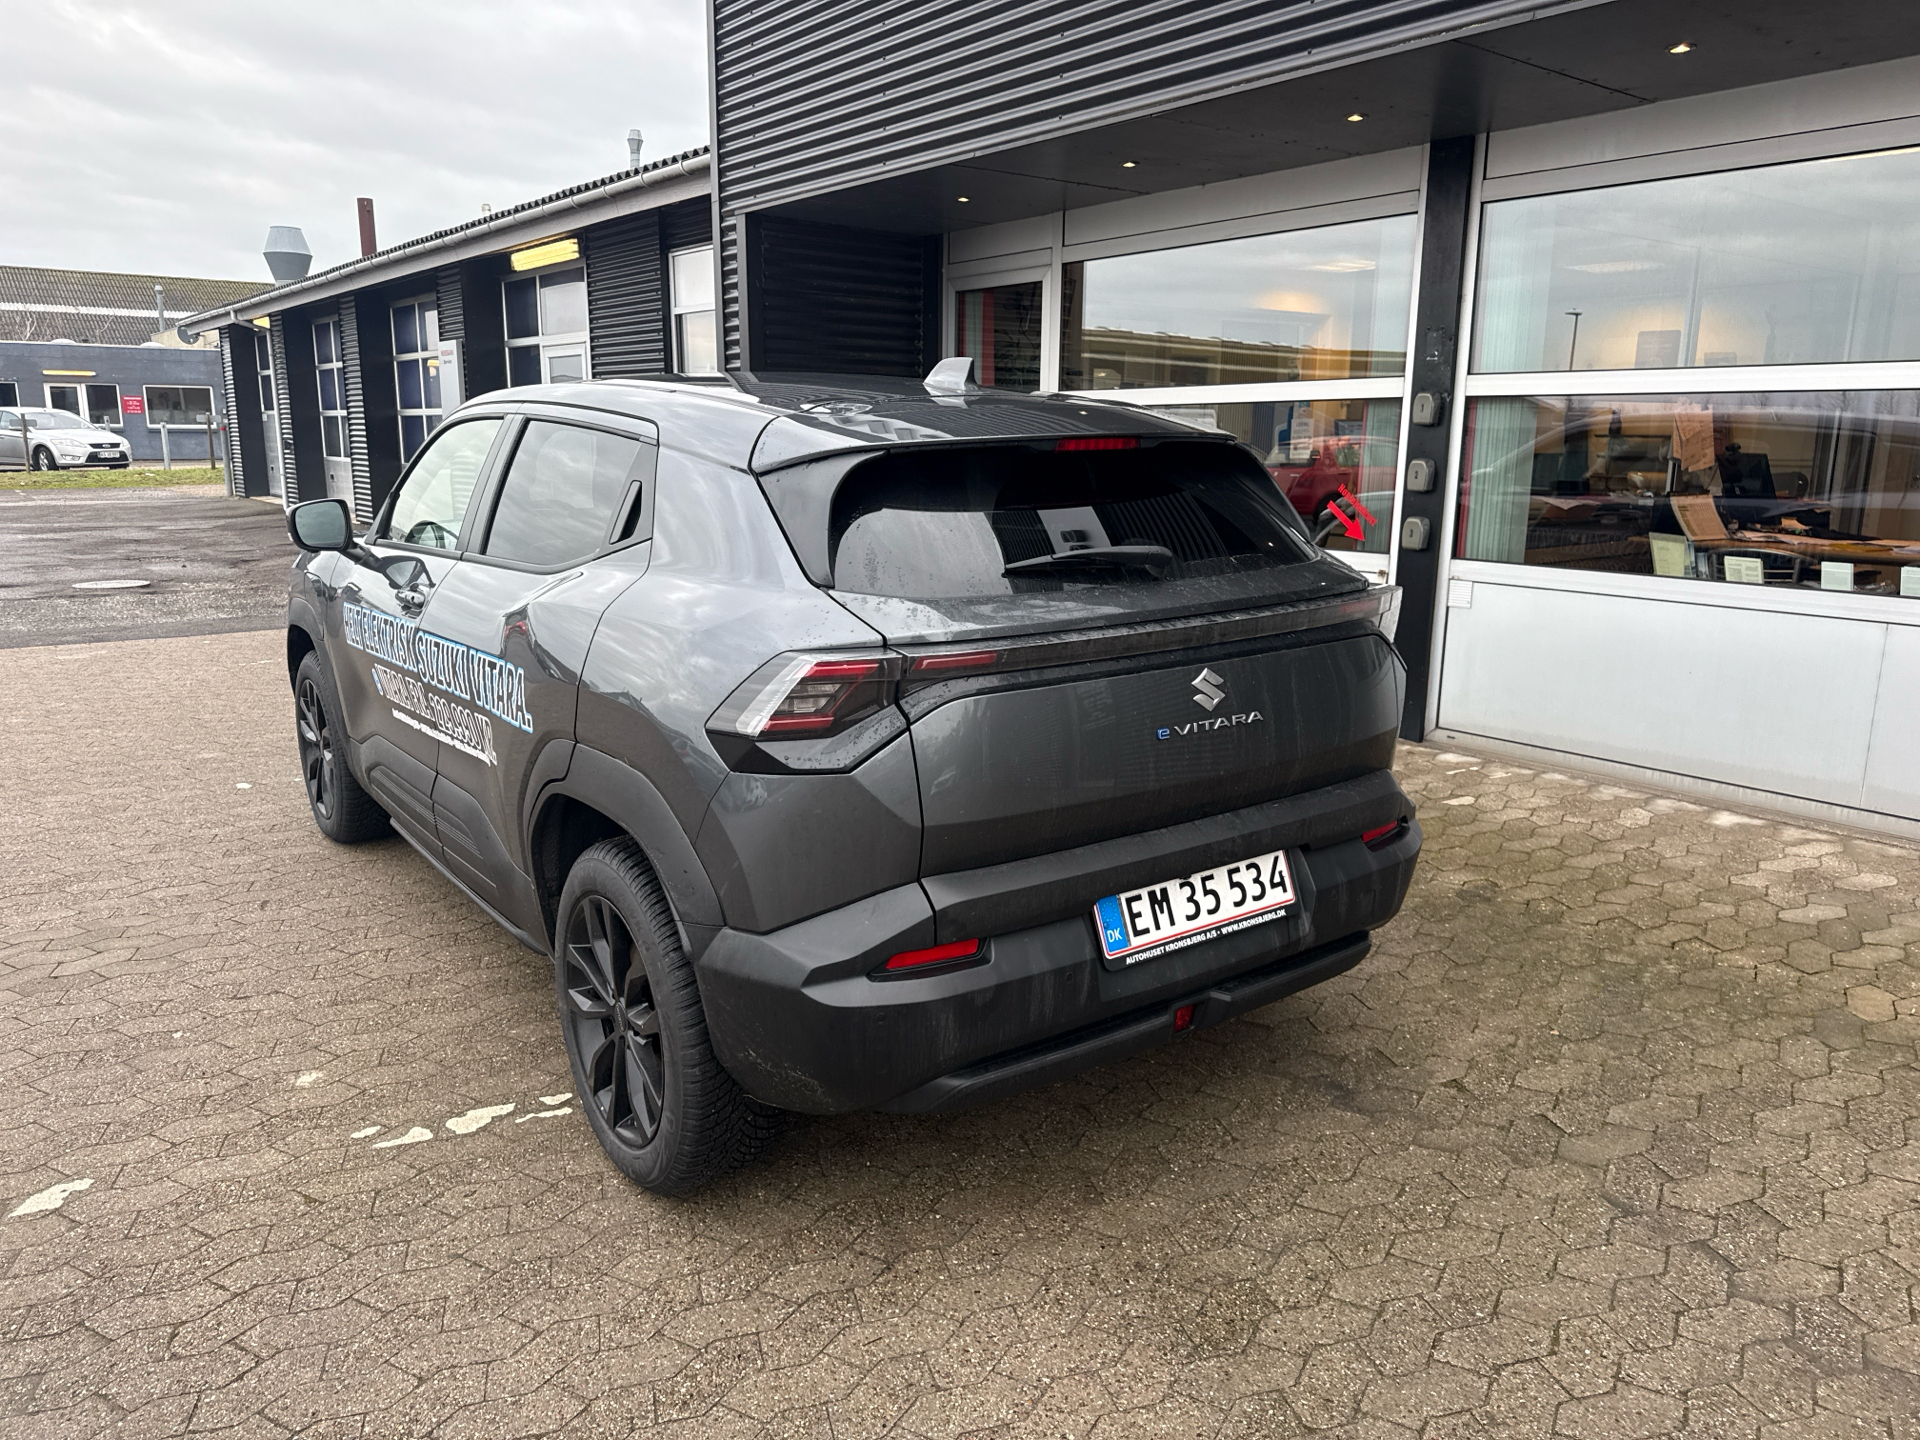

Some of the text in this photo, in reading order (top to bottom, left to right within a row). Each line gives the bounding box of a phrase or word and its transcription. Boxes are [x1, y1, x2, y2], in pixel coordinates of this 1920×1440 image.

[1419, 403, 1425, 413] 1
[1414, 470, 1419, 479] 2
[1409, 529, 1414, 538] 3
[343, 601, 533, 733] HELT ELEKTRISK SUZUKI VITARA.
[428, 692, 482, 750] 229.990
[1124, 855, 1289, 938] EM 35 534
[1107, 927, 1123, 943] DK
[1126, 908, 1286, 965] AUTOHUSET KRONSBJERG A/S WWW.KRONSBJERG.DK
